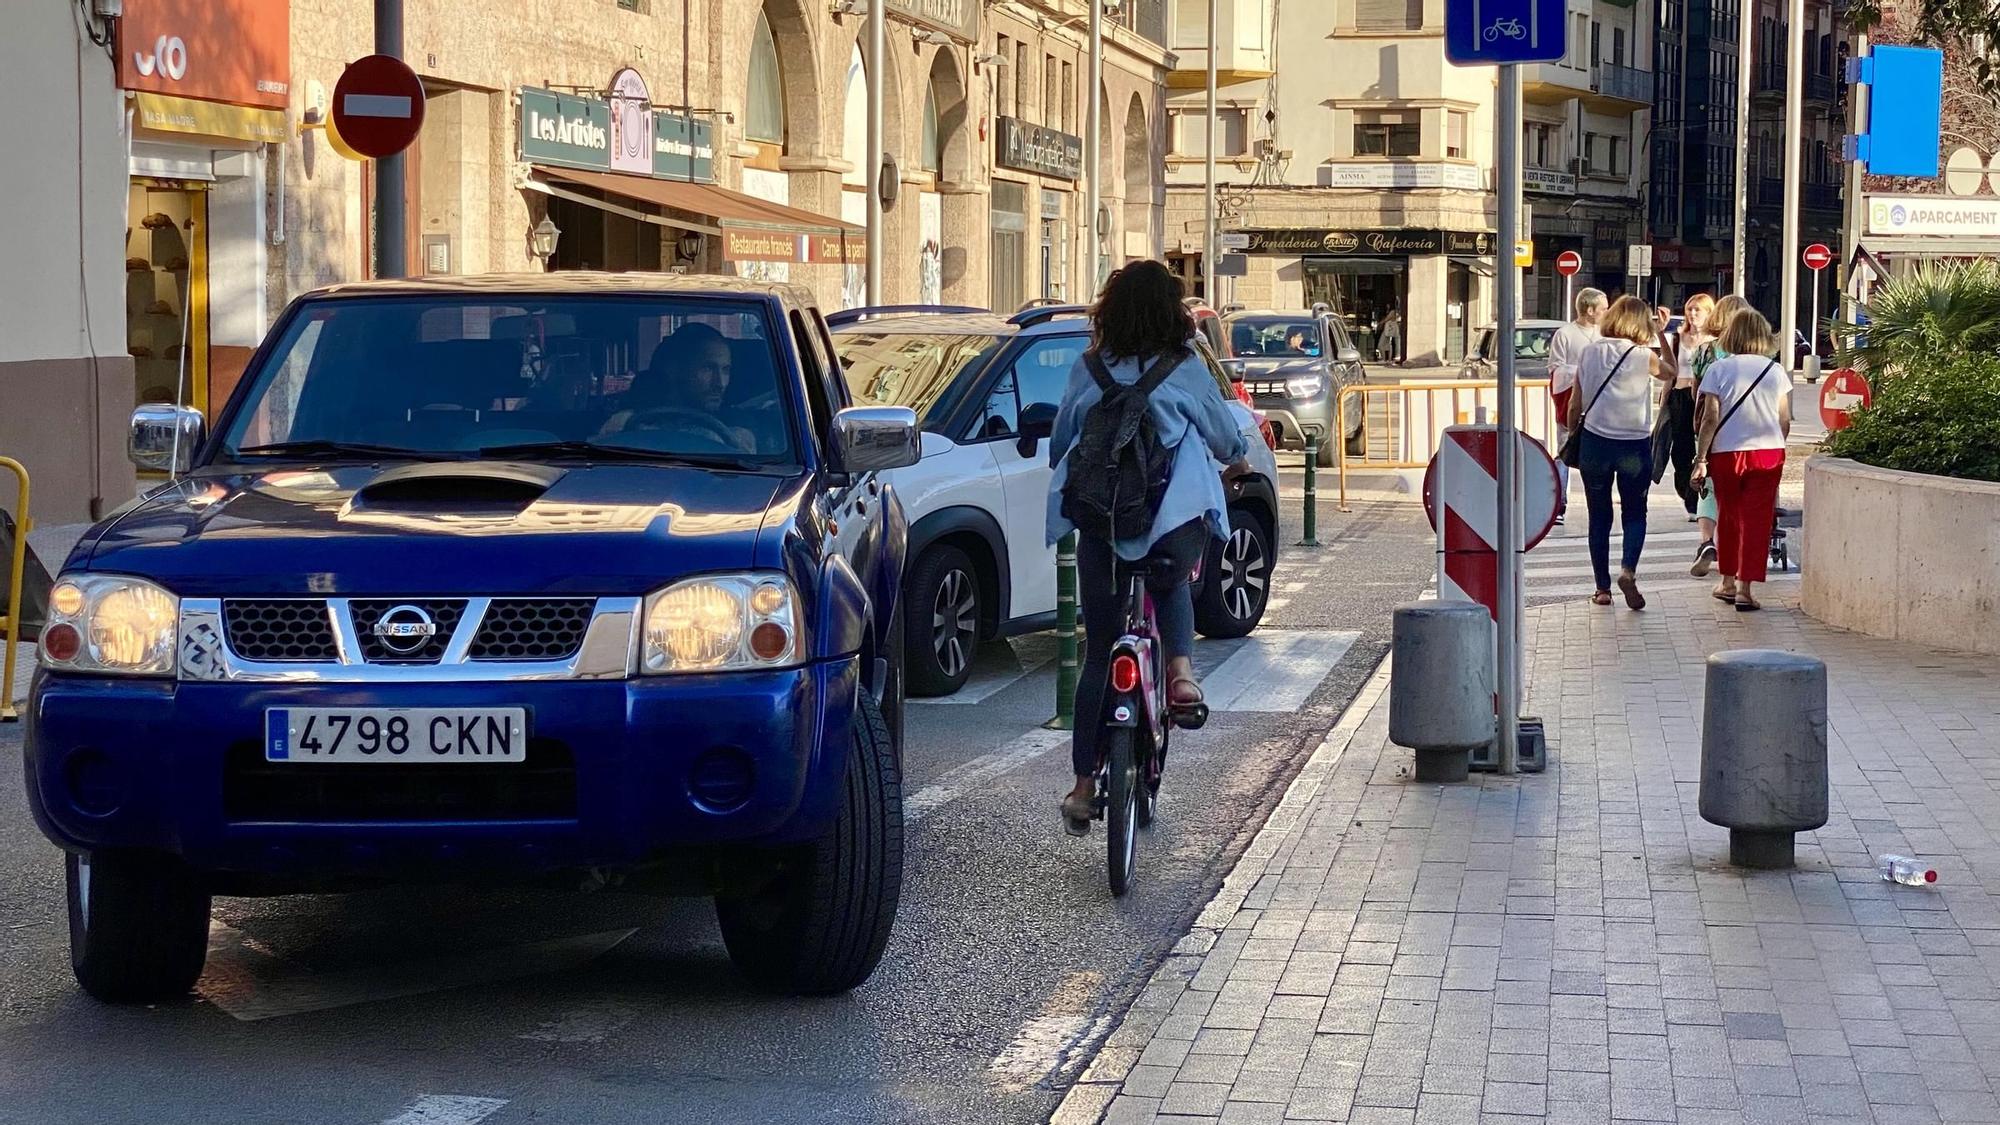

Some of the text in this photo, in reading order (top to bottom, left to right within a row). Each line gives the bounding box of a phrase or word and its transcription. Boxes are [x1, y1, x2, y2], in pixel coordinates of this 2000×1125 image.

[257, 80, 288, 95] BAKERY
[531, 111, 556, 142] Les
[556, 115, 606, 150] Artistes
[1910, 210, 1997, 225] APARCAMENT
[730, 232, 793, 257] Restaurante francés
[822, 238, 840, 258] Carne
[1248, 233, 1321, 250] Panadería
[1365, 233, 1436, 253] Cafetería
[380, 624, 429, 634] NISSAN
[274, 739, 284, 751] E
[299, 715, 512, 755] 4798 CKN
